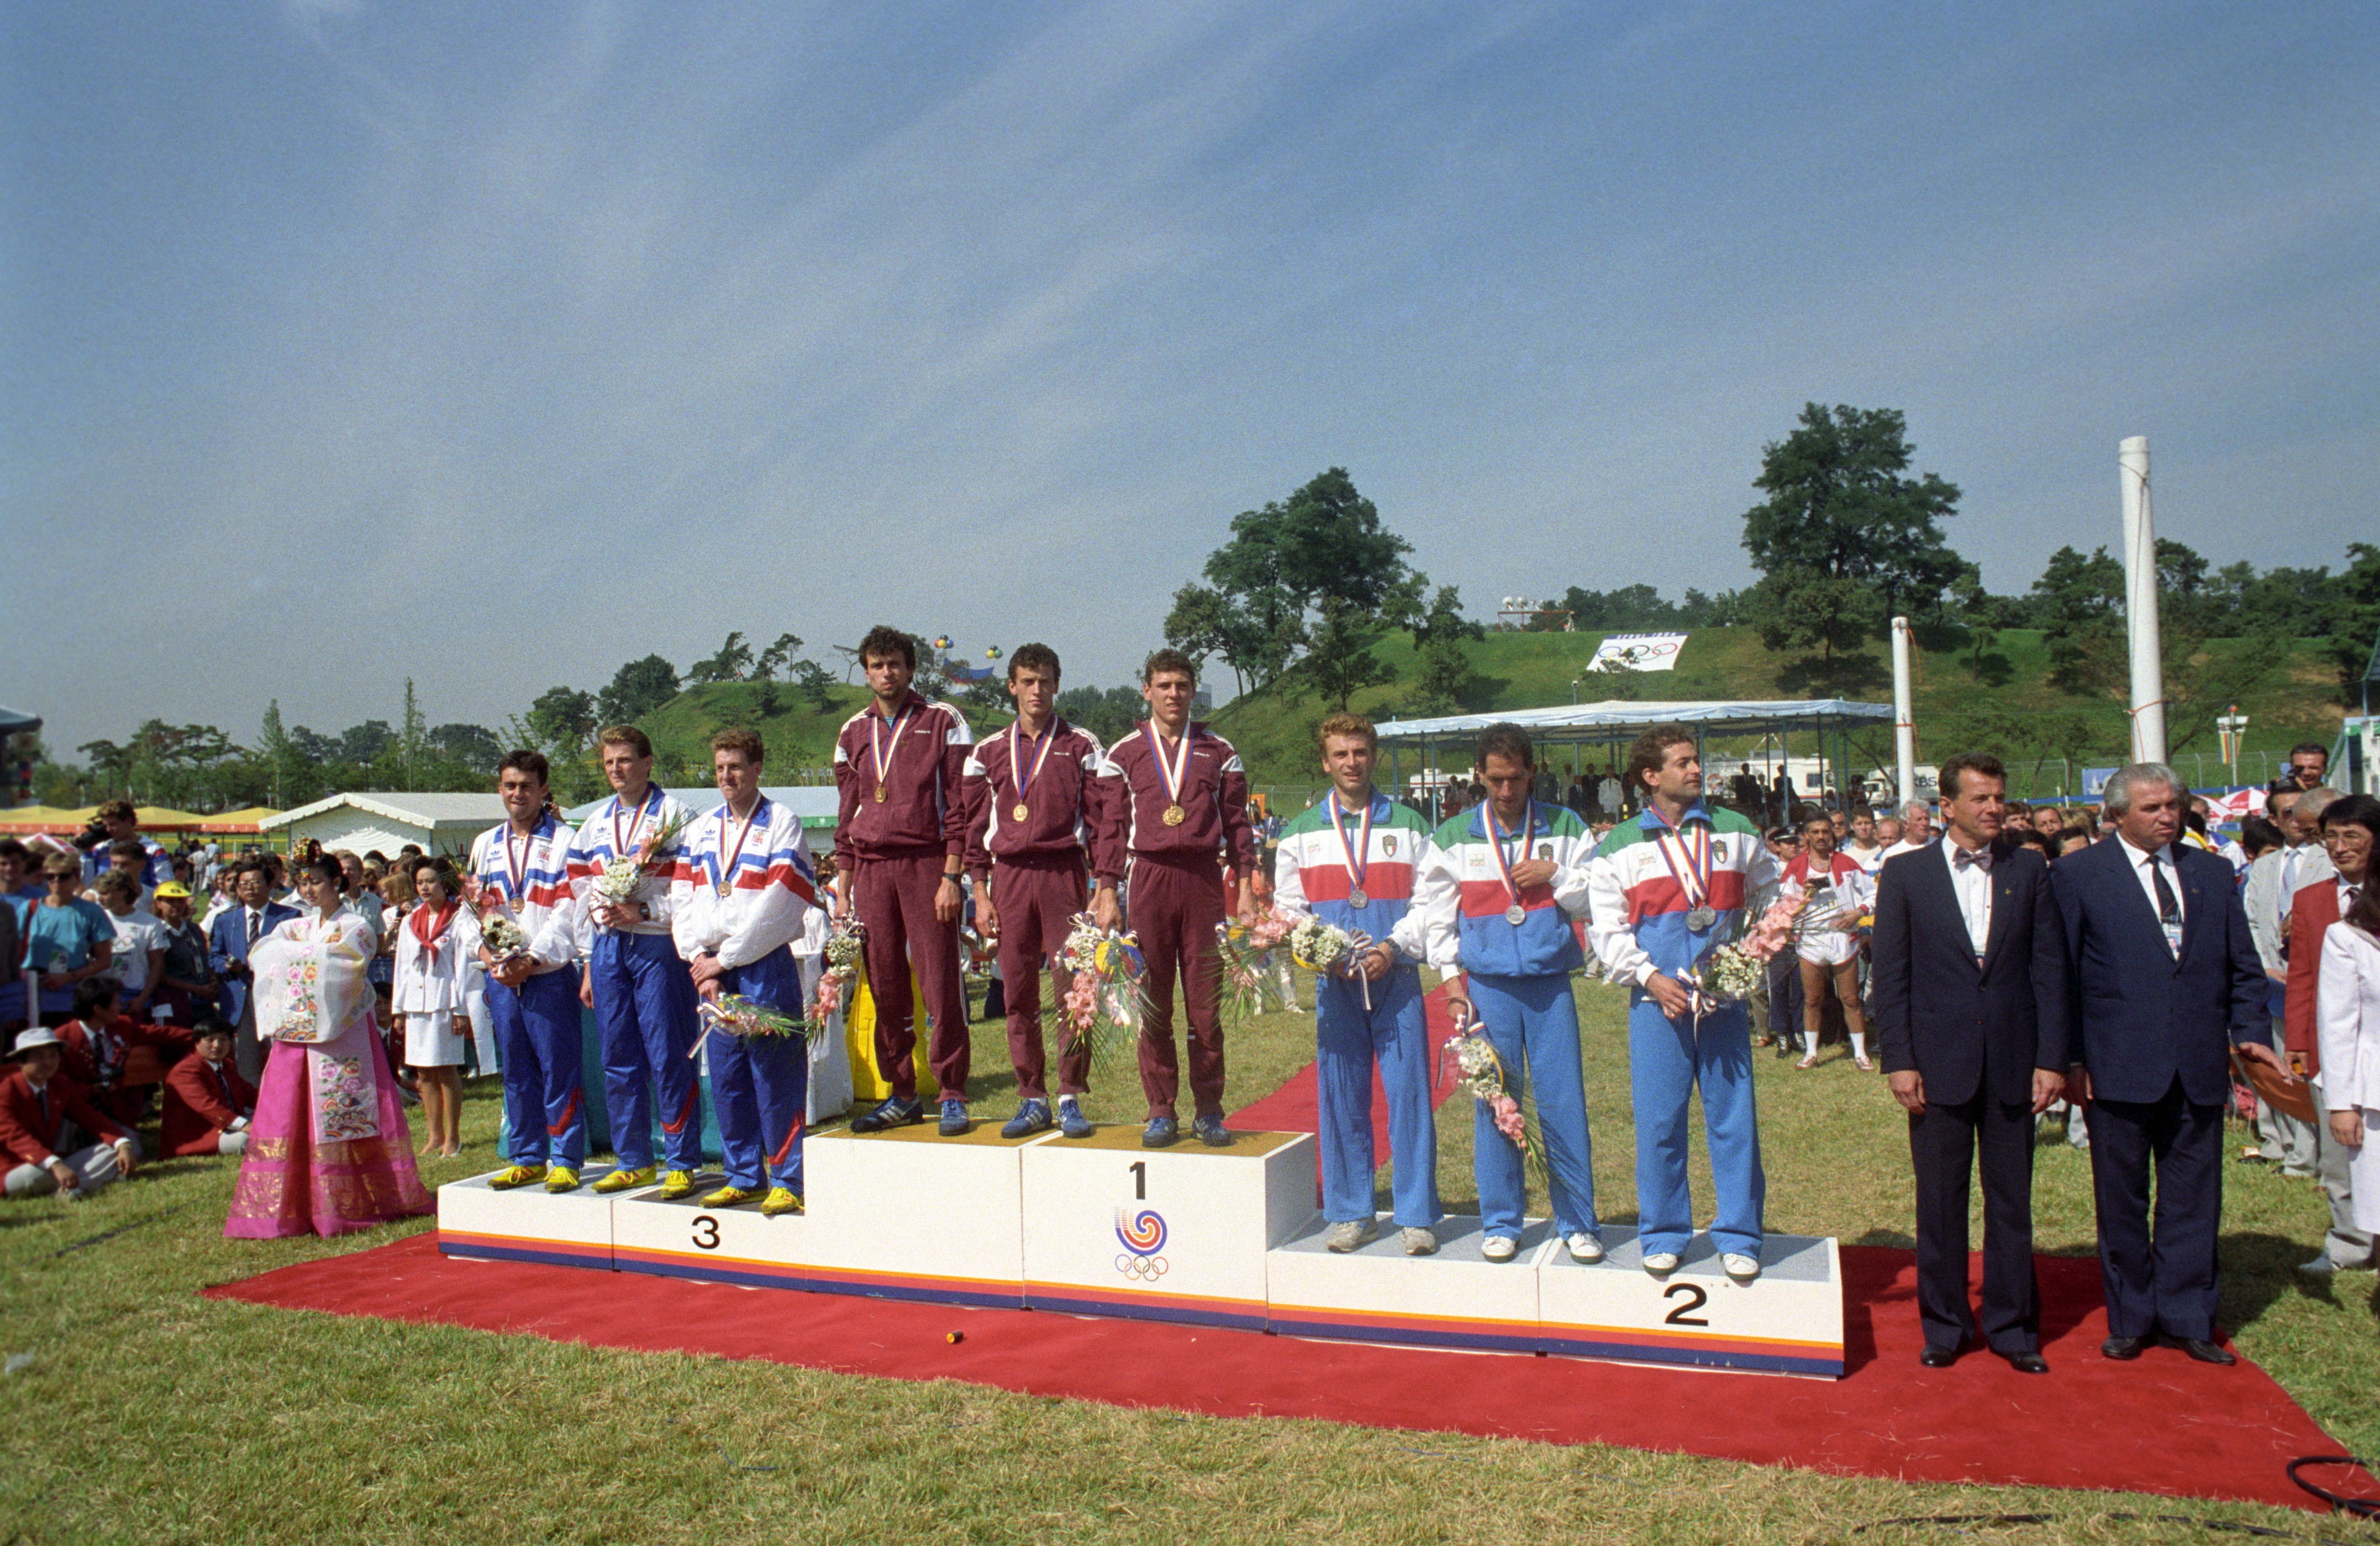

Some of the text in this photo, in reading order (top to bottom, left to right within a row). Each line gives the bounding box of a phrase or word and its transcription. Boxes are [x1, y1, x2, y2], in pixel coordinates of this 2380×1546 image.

[1130, 1162, 1145, 1199] 1
[692, 1216, 720, 1249] 3
[1663, 1283, 1709, 1326] 2
